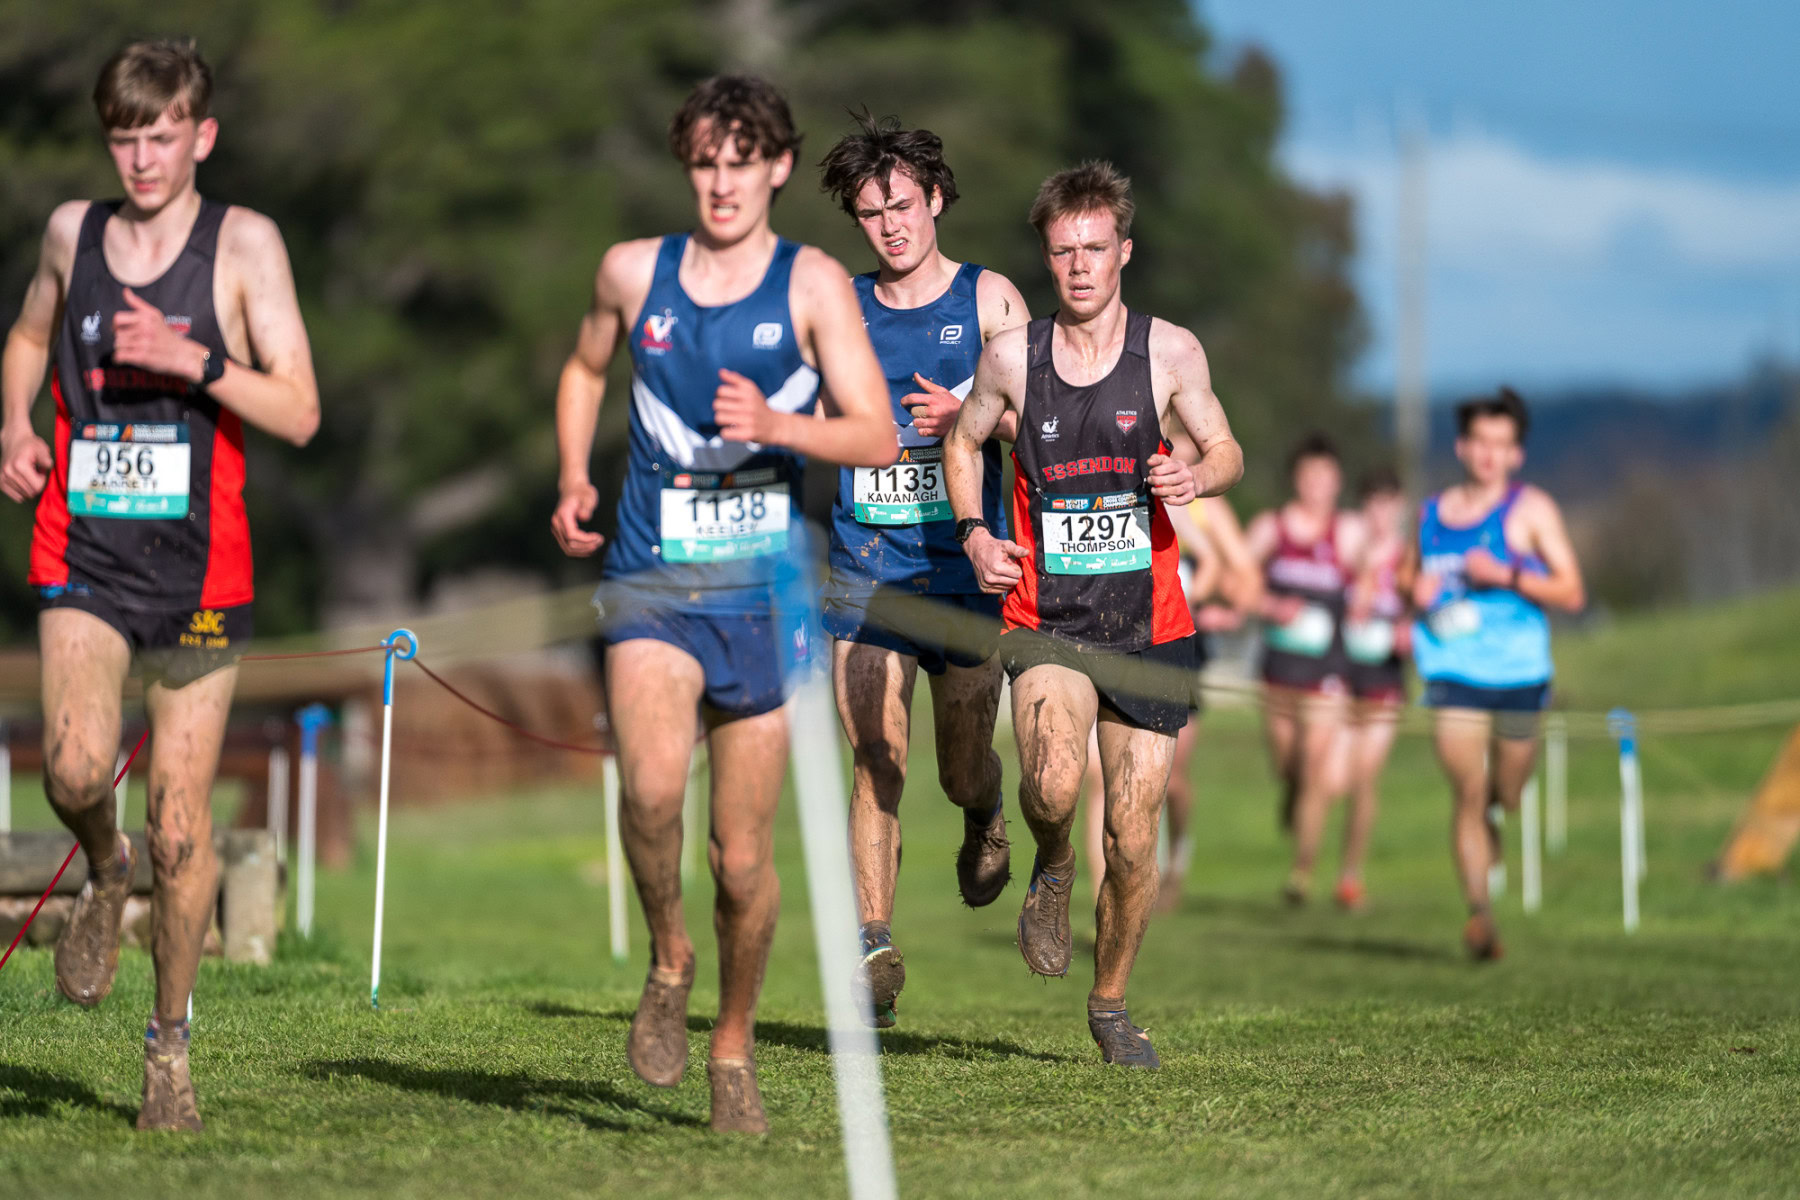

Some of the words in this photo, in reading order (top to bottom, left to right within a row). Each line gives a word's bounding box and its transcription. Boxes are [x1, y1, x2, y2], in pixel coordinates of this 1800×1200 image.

[97, 443, 154, 476] 956
[1042, 456, 1136, 482] ESSENDON
[869, 464, 938, 493] 1135
[685, 488, 767, 522] 1138
[867, 490, 939, 504] KAVANAGH
[1061, 512, 1132, 542] 1297
[1060, 538, 1136, 553] THOMPSON
